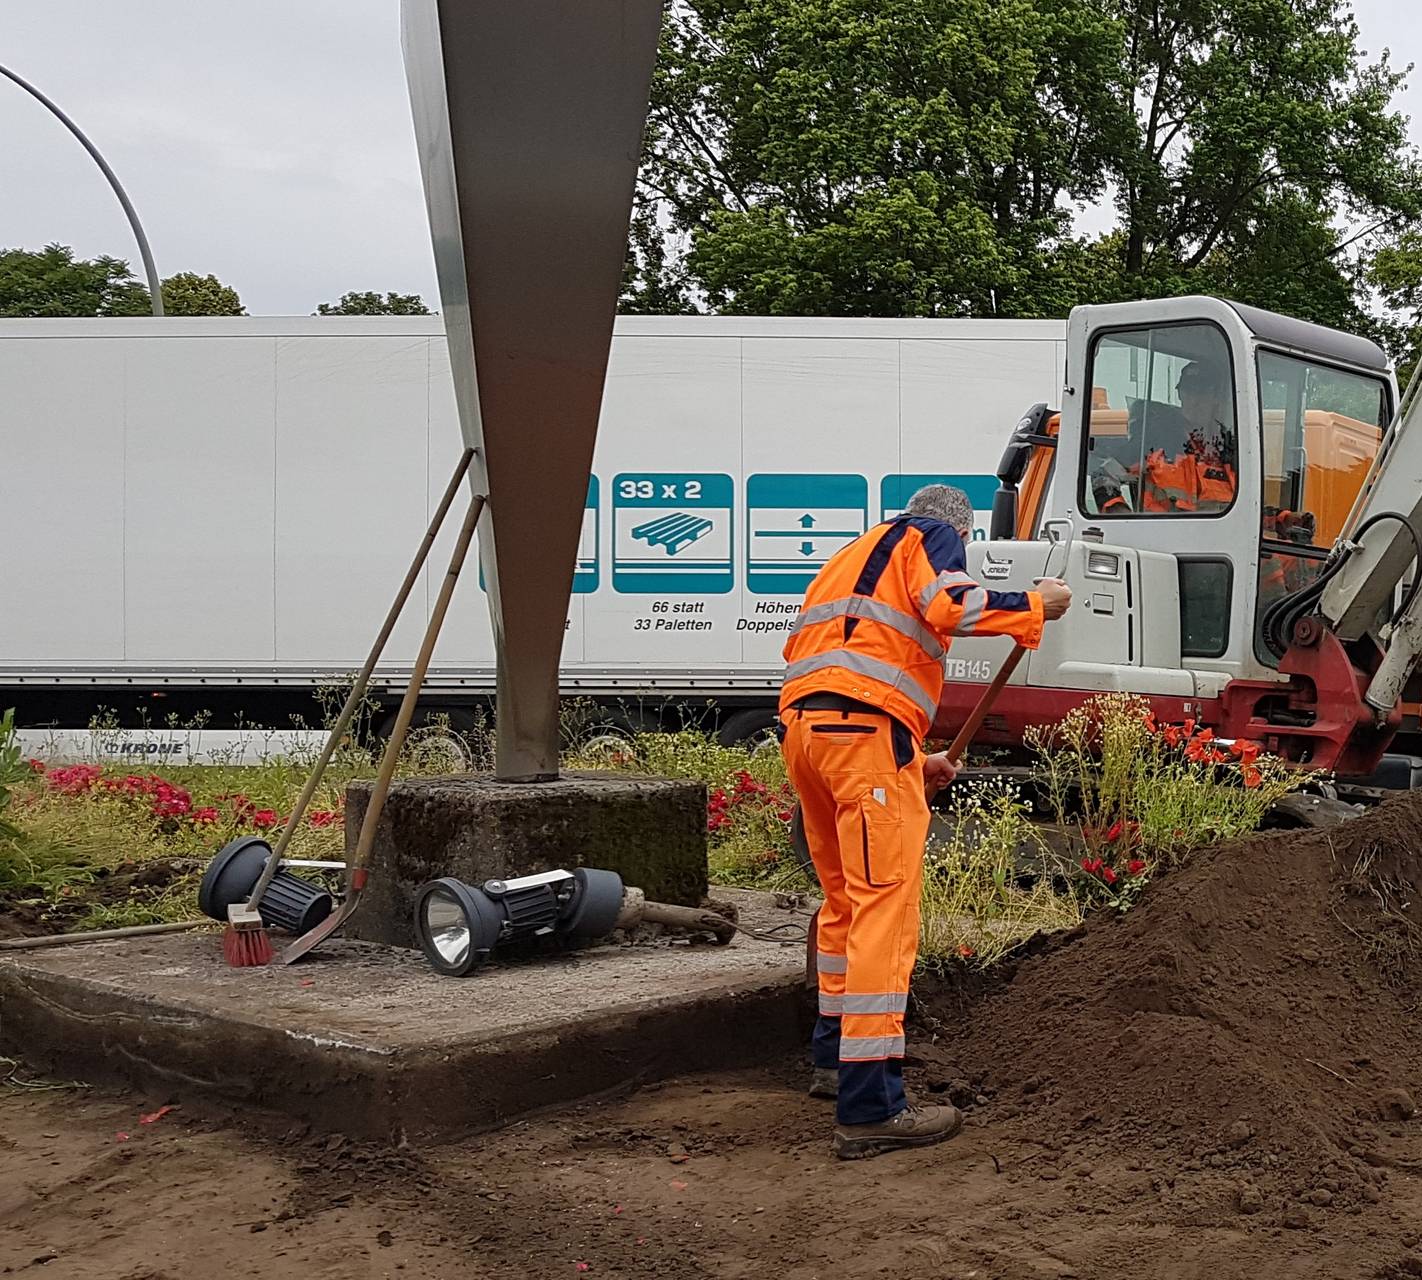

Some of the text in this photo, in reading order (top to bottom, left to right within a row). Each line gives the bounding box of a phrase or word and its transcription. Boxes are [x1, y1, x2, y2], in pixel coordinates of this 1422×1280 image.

[620, 480, 701, 499] 33 x 2
[652, 601, 704, 613] 66 statt
[634, 618, 712, 630] 33 Paletten
[946, 658, 991, 680] TB145
[120, 742, 184, 754] KRONE
